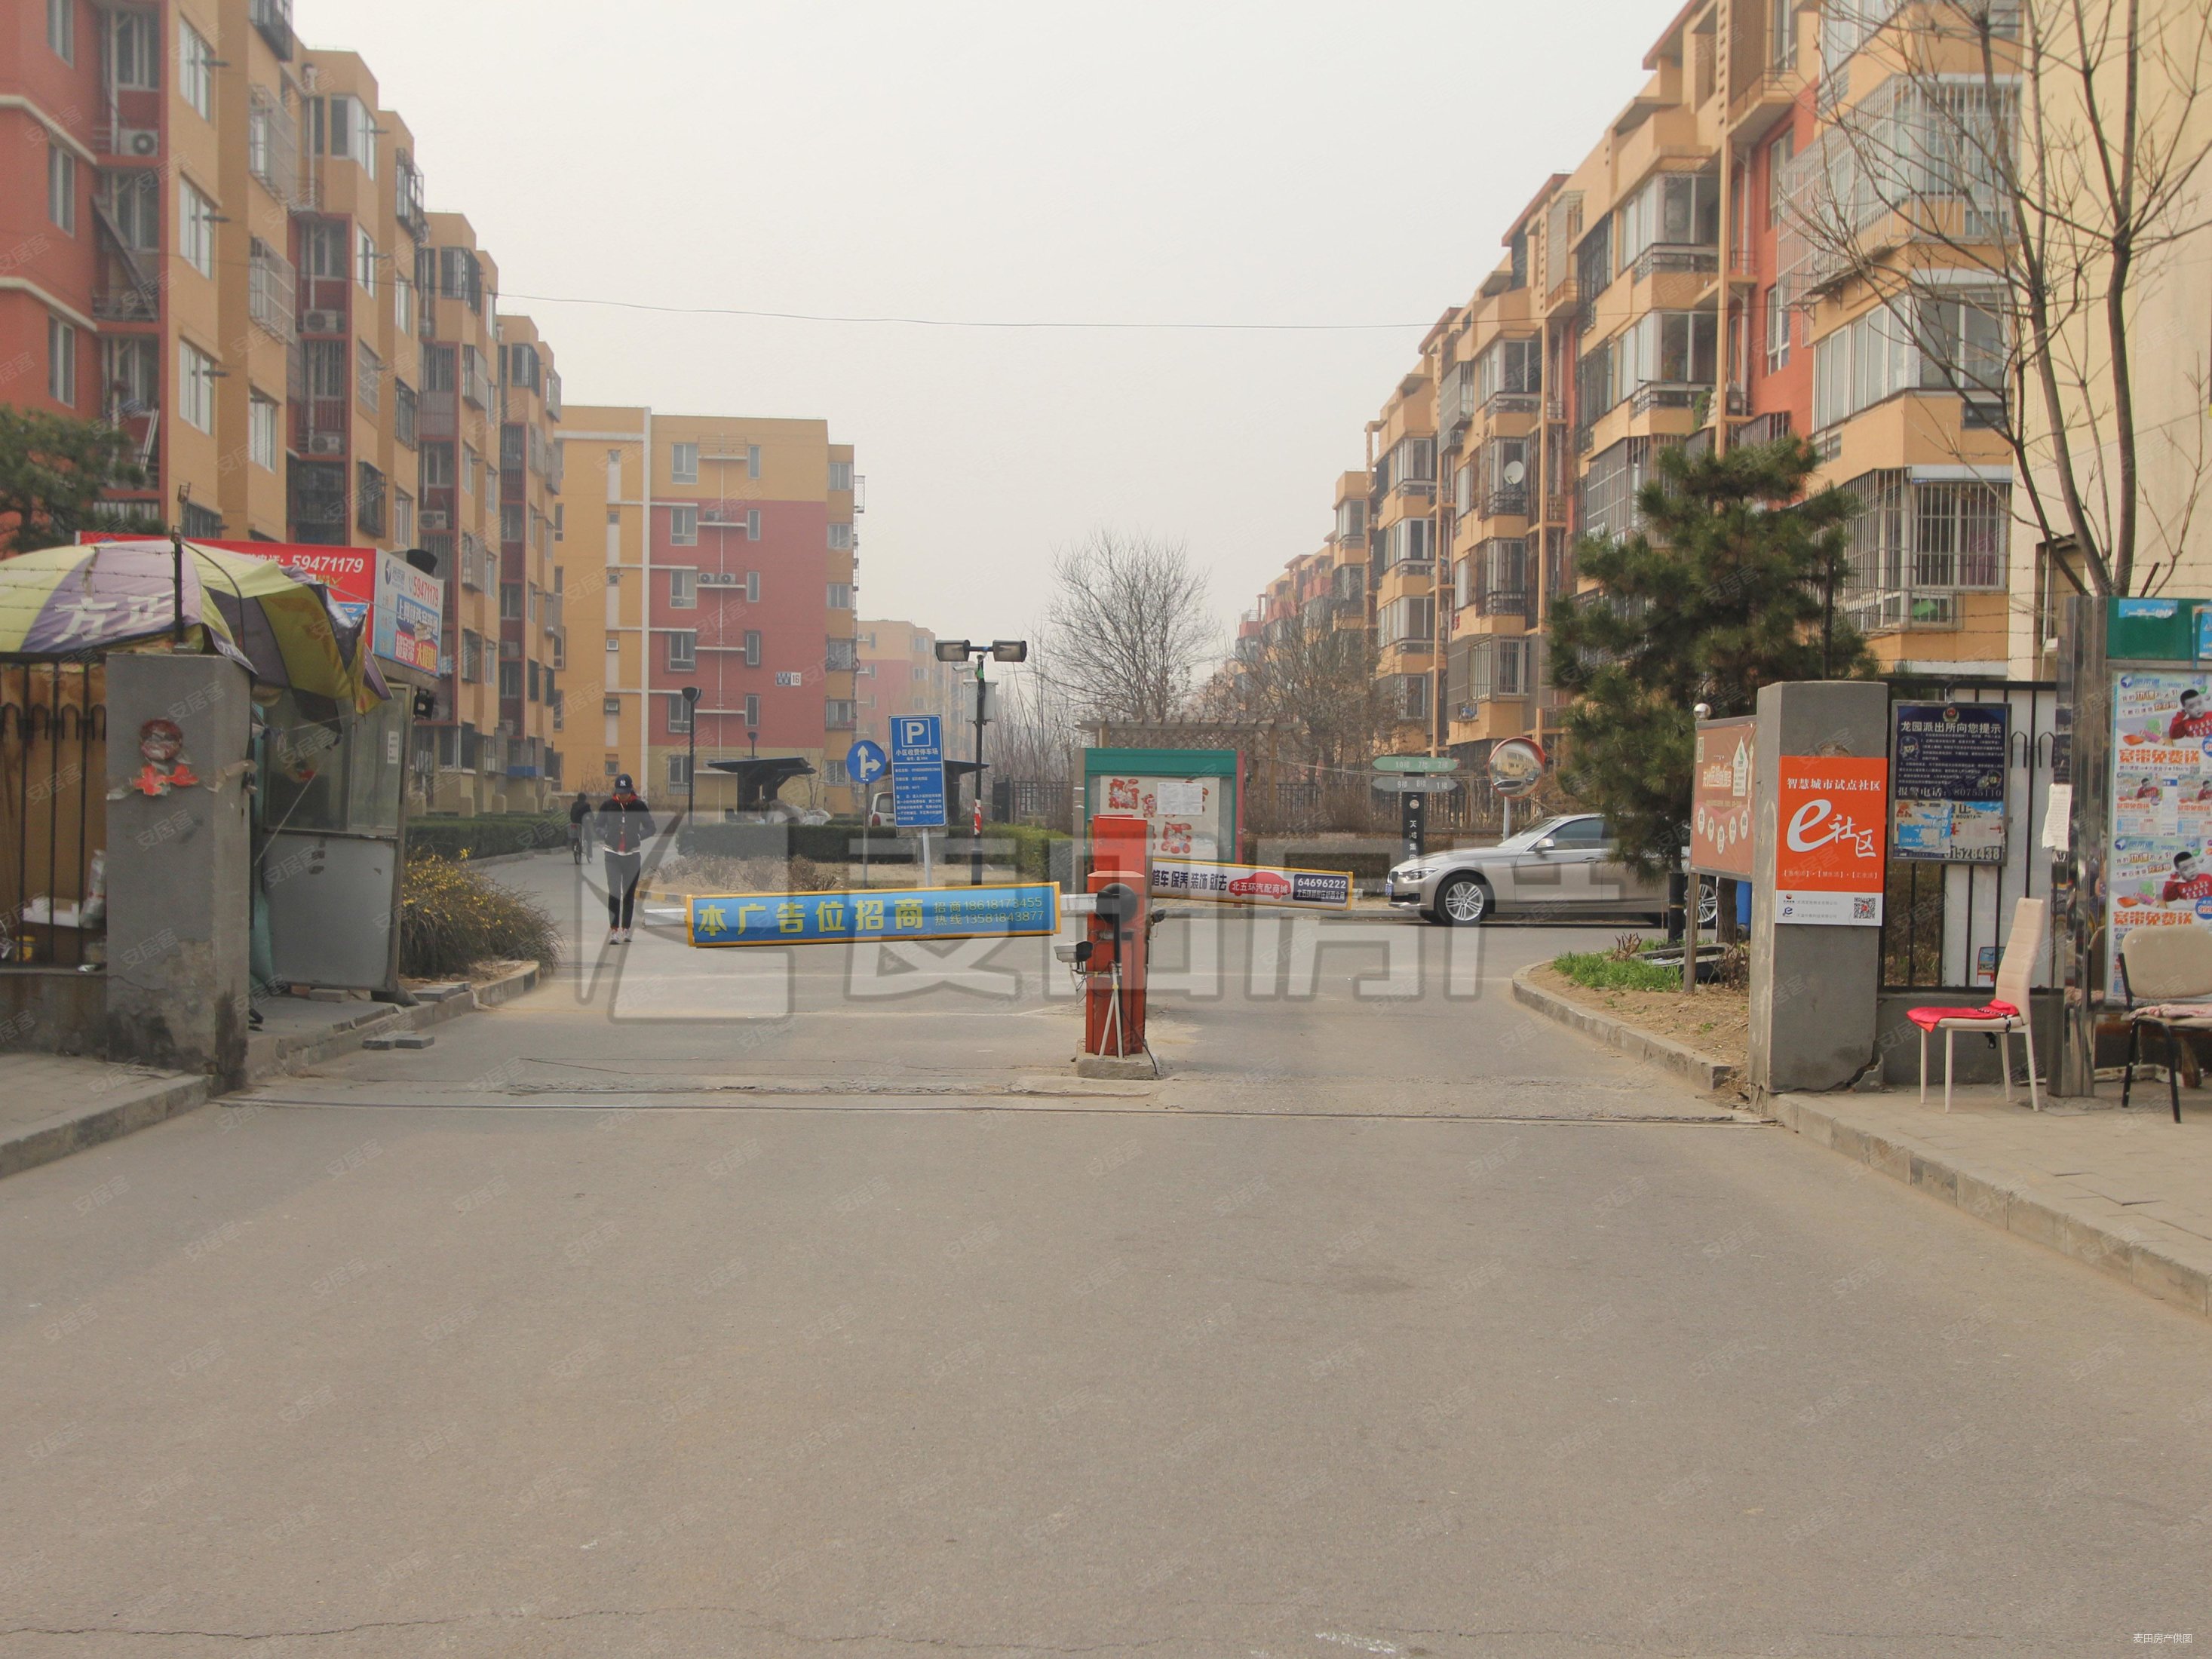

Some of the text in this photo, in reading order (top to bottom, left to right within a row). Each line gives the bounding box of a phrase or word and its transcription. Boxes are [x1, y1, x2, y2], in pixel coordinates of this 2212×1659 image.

[292, 554, 364, 573] 59471179
[413, 576, 439, 607] 59471179
[792, 674, 800, 684] 16
[906, 722, 925, 744] P
[1901, 721, 2002, 734] 龙园派出所向您提示
[895, 747, 939, 756] 小区收费停车场
[2119, 749, 2200, 765] 宽带免费送
[1787, 777, 1881, 791] 智慧城市试点社区
[1787, 799, 1876, 858] e社区
[1171, 871, 1188, 888] 保养
[1191, 872, 1208, 890] 装饰
[1210, 874, 1227, 891] 就去
[1232, 881, 1289, 894] 北五环汽配商城
[1298, 877, 1346, 889] 64696222
[698, 898, 924, 936] 本广告位招商
[2112, 911, 2192, 925] 宽带免费送
